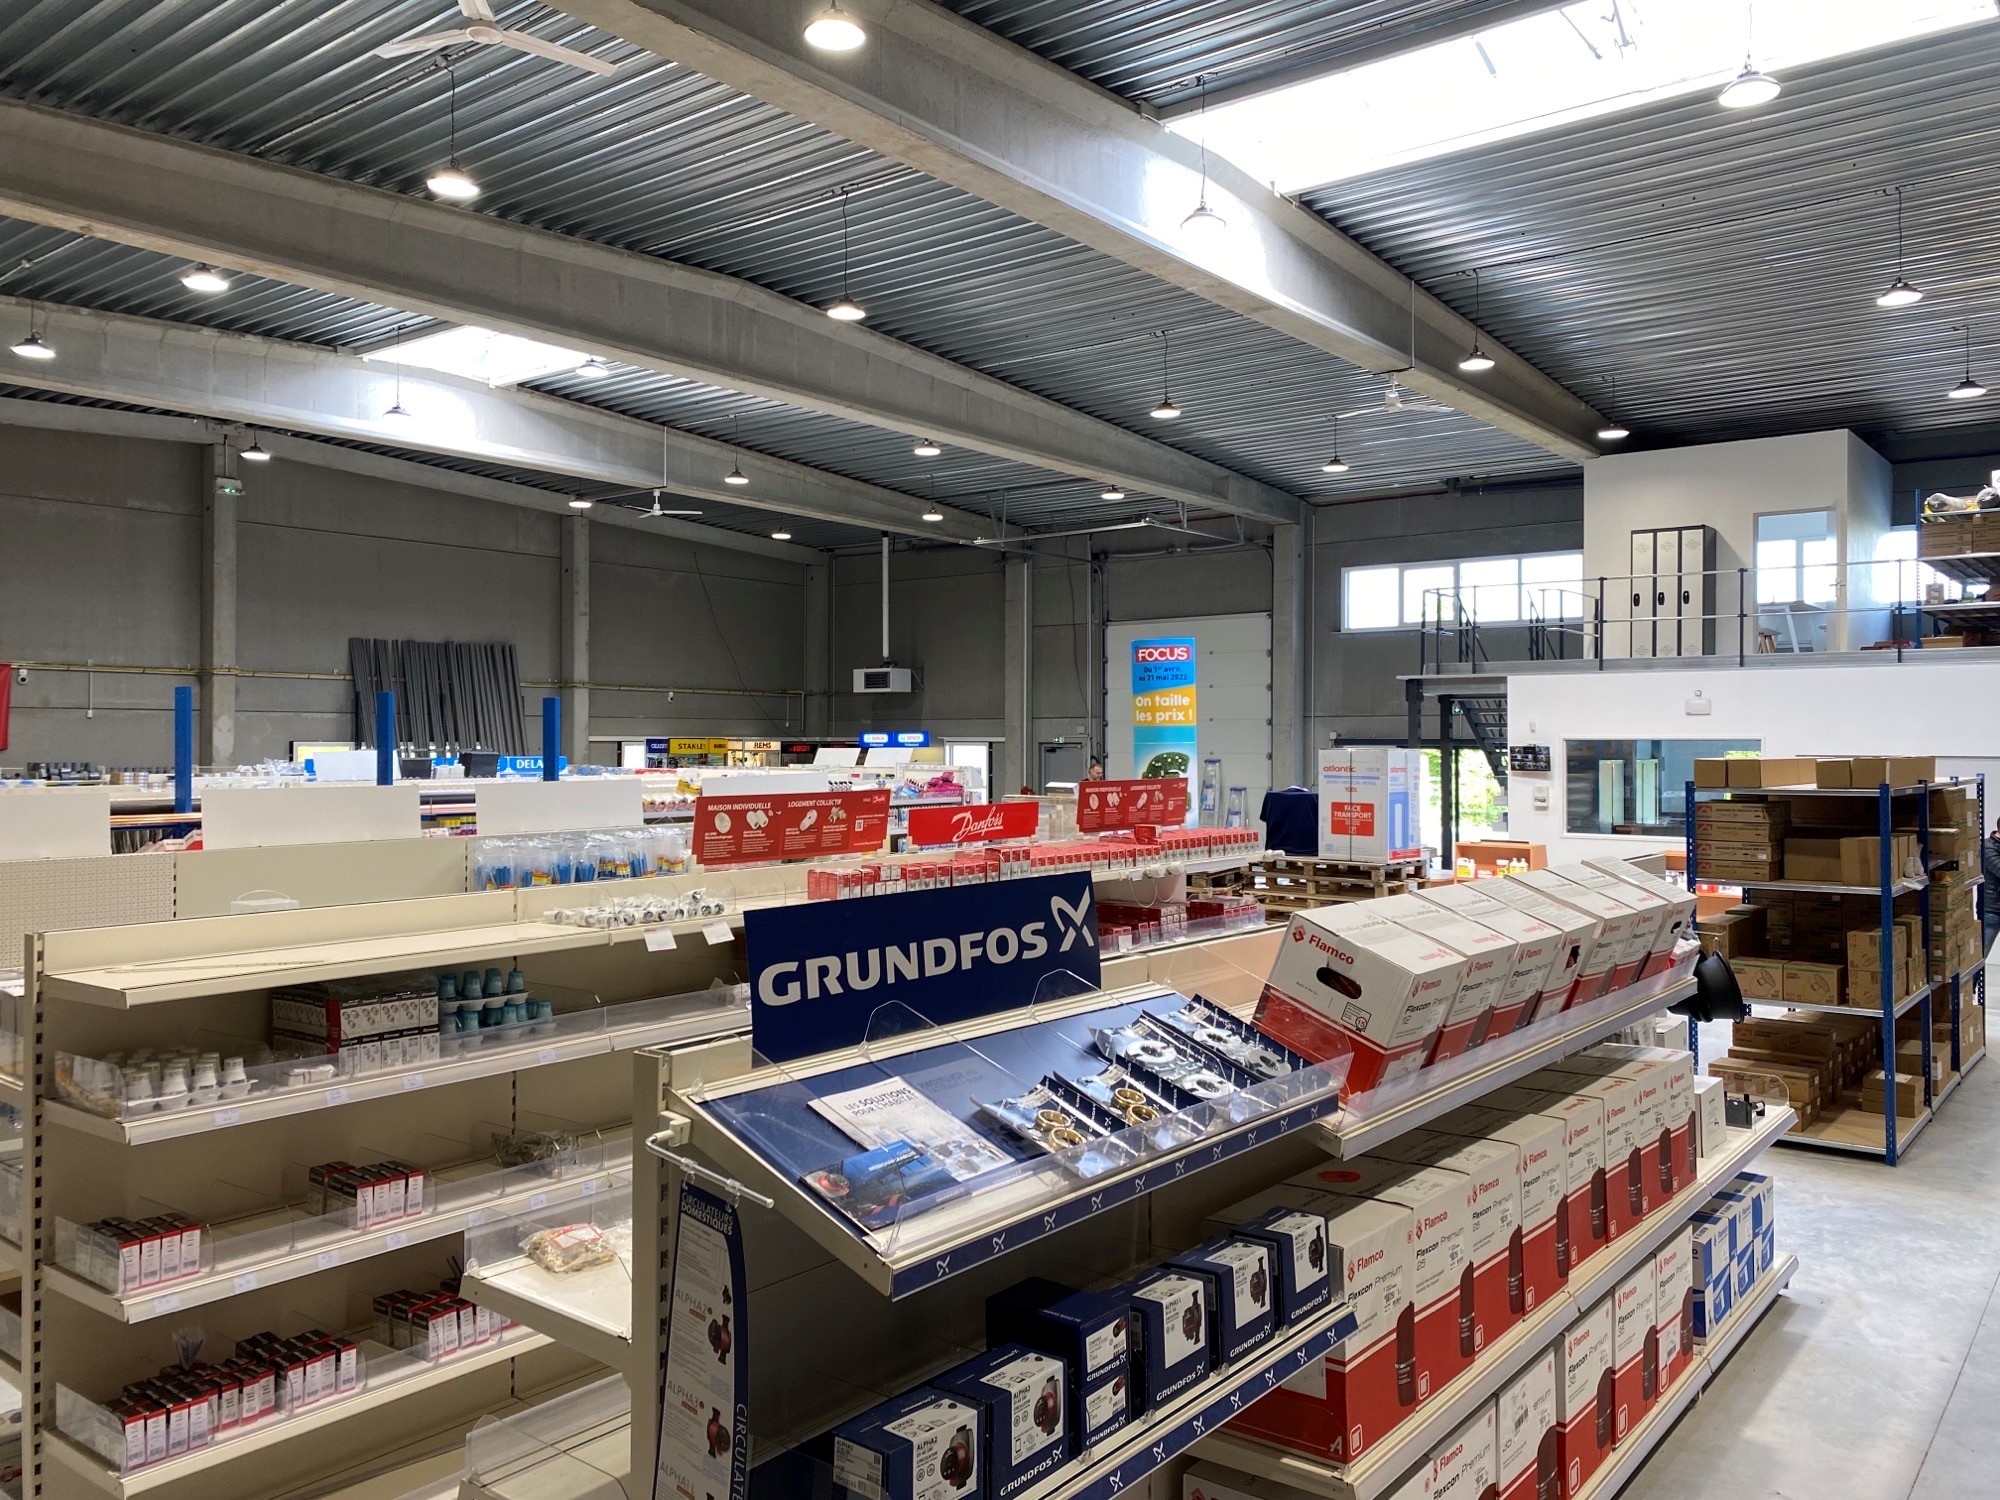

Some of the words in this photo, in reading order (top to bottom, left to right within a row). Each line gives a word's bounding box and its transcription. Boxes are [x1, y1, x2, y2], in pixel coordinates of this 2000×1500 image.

[1137, 647, 1188, 661] FOCUS
[1135, 696, 1151, 707] On
[1155, 694, 1190, 706] taille
[1136, 710, 1152, 722] les
[1156, 708, 1186, 723] prix
[1323, 765, 1356, 773] atlantic
[707, 803, 732, 812] MAISON
[732, 802, 772, 811] INDIVIDUELLE
[787, 800, 816, 808] LOGEMENT
[817, 799, 842, 807] COLLECTIF
[1333, 811, 1373, 819] TRANSPORT
[951, 806, 1004, 842] Danfoss
[1308, 934, 1354, 966] Flamco
[1525, 949, 1543, 959] Flamco
[758, 921, 1049, 1007] GRUNDFOS
[1474, 961, 1494, 972] Flamco
[1512, 968, 1533, 978] Flexcon
[1420, 979, 1442, 992] Flamco
[1461, 981, 1483, 993] Flexcon
[1405, 1002, 1432, 1014] Flexcon
[844, 1102, 860, 1110] LES
[858, 1087, 911, 1107] SOLUTIONS
[1643, 1088, 1657, 1099] Flamco
[852, 1106, 875, 1116] POUR
[1610, 1106, 1626, 1117] Flamco
[1573, 1125, 1589, 1139] Flamco
[1607, 1126, 1620, 1136] Flexcon
[1529, 1149, 1548, 1165] Flamco
[1568, 1147, 1583, 1158] Flexcon
[1479, 1178, 1500, 1195] Flamco
[1523, 1175, 1541, 1188] Flexcon
[681, 1191, 734, 1226] CIRCULATEURS
[1472, 1205, 1492, 1220] Flexcon
[1492, 1192, 1513, 1208] Premium
[681, 1202, 733, 1236] DOMESTIQUES
[1424, 1211, 1448, 1231] Flamco
[1416, 1241, 1439, 1259] Flexcon
[1440, 1226, 1464, 1245] Premium
[1357, 1249, 1384, 1272] Flamco
[1663, 1251, 1677, 1267] Flamco
[1347, 1283, 1373, 1304] Flexcon
[1374, 1265, 1403, 1287] Premium
[1659, 1272, 1676, 1289] Flexcon
[675, 1288, 707, 1314] ALPHA2
[1622, 1286, 1637, 1302] Flamco
[1291, 1295, 1322, 1319] GRUNDFOS
[1617, 1308, 1635, 1327] Flexcon
[1230, 1330, 1265, 1358] GRUNDFOS
[1573, 1329, 1590, 1349] Flamco
[1086, 1360, 1120, 1382] GRUNDFOS
[1567, 1354, 1588, 1375] Flexcon
[1013, 1385, 1031, 1400] ALPHA2
[1156, 1371, 1196, 1402] GRUNDFOS
[1086, 1422, 1119, 1446] GRUNDFOS
[916, 1436, 938, 1450] ALPHA2
[1440, 1443, 1463, 1472] Flamco
[1000, 1456, 1053, 1497] GRUNDFOS
[1433, 1473, 1460, 1500] Flexcon
[1460, 1444, 1491, 1478] Premium
